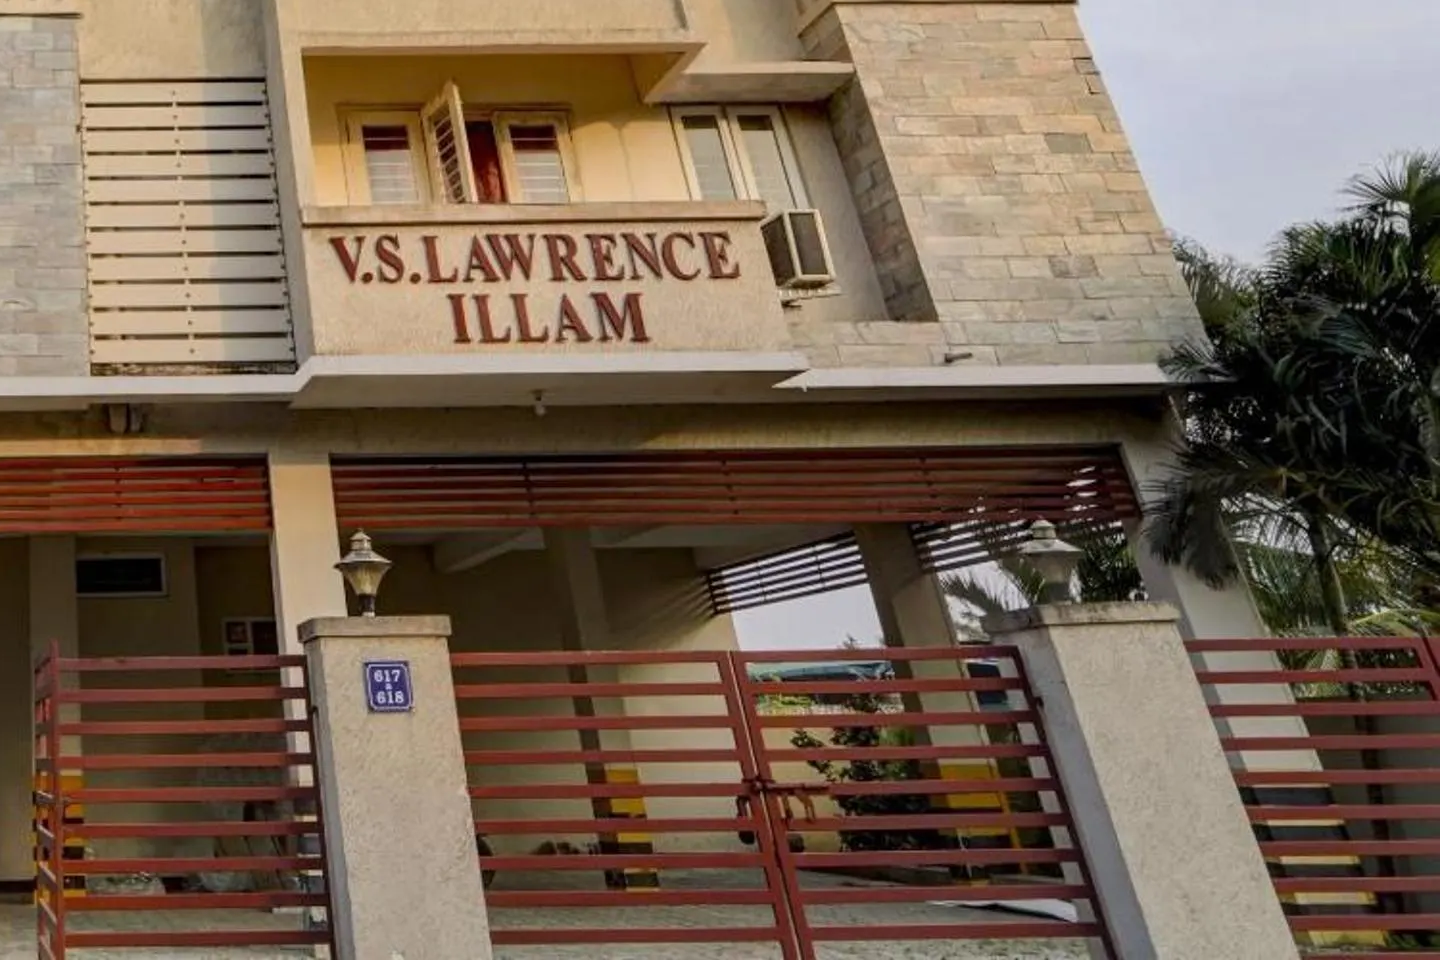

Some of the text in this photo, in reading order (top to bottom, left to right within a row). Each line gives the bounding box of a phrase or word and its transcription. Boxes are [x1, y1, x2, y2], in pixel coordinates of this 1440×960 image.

[447, 292, 652, 346] ILLAM
[374, 669, 400, 682] 617
[377, 691, 404, 704] 618
